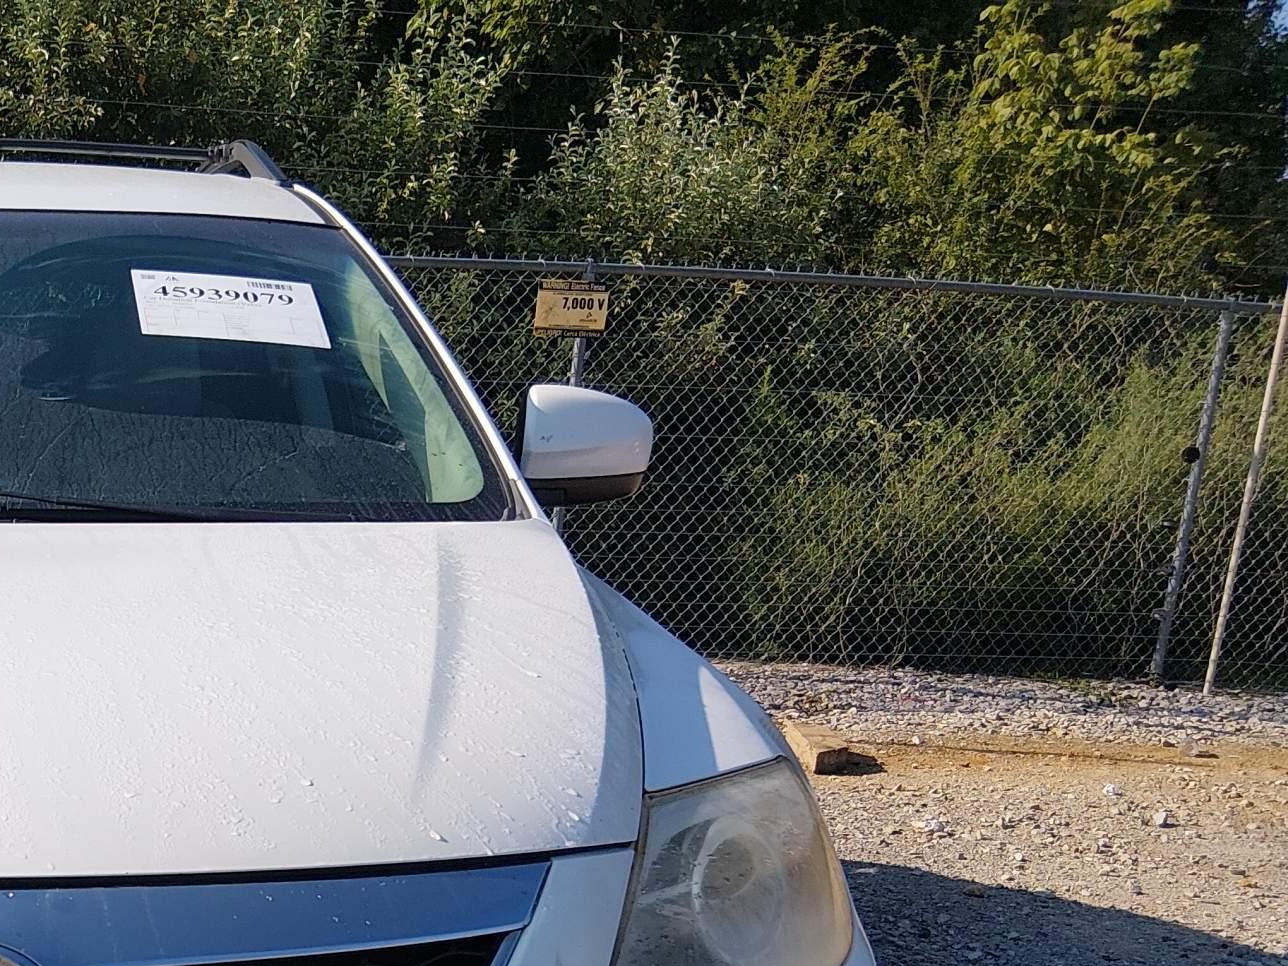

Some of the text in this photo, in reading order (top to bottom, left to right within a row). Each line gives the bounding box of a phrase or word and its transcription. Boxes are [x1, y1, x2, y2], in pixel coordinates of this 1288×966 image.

[153, 285, 294, 306] 45939079
[562, 297, 605, 311] 7,000 V
